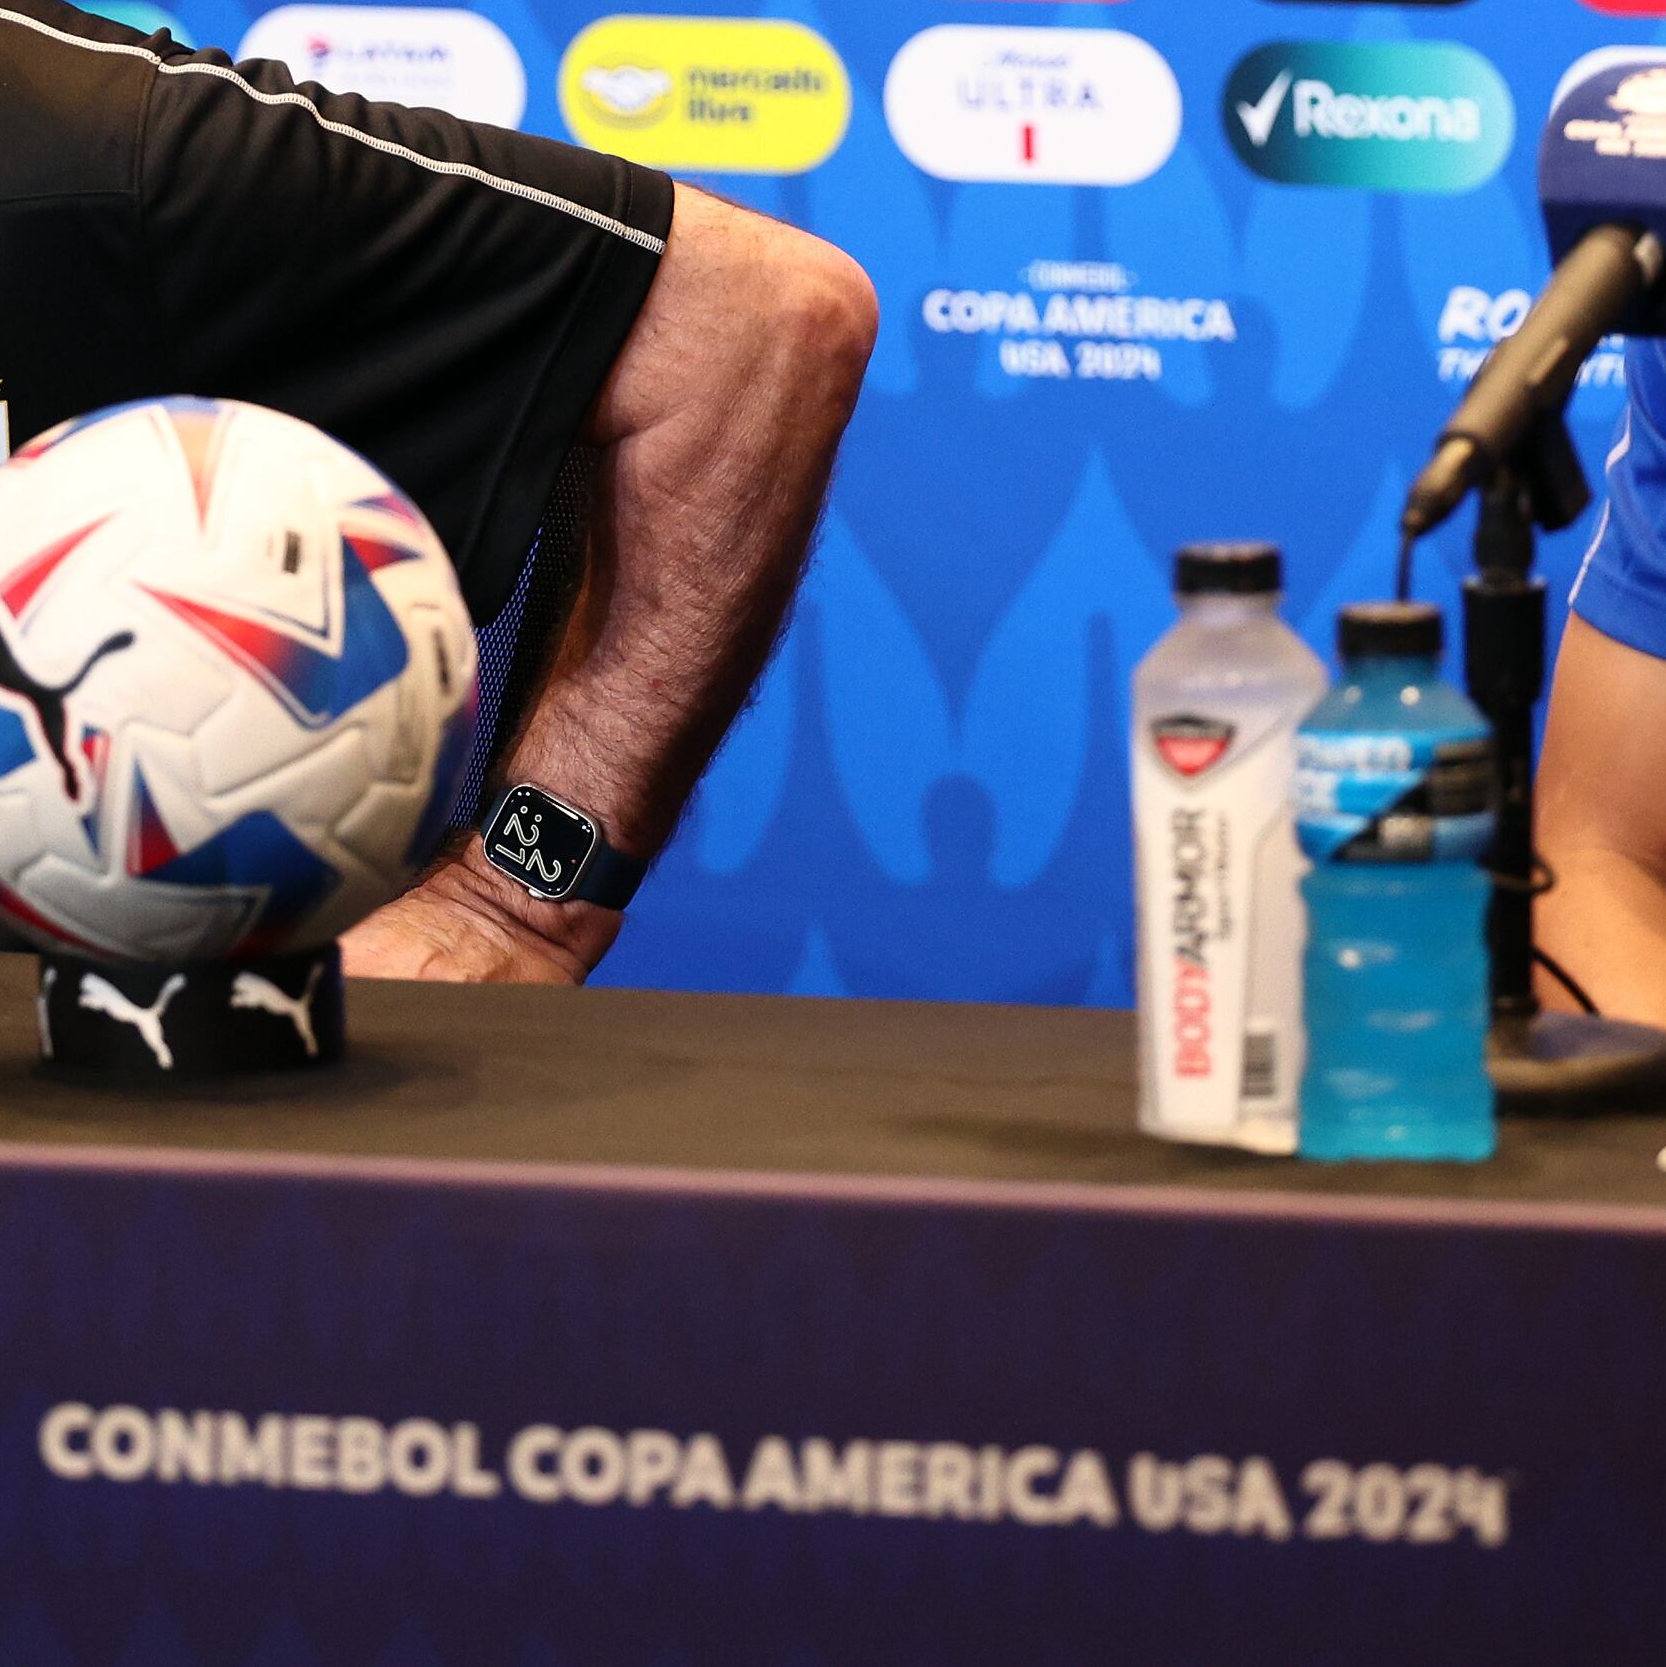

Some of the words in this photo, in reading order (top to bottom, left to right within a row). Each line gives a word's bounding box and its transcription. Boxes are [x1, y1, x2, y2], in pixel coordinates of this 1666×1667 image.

[959, 78, 1102, 112] ULTRA
[1293, 85, 1477, 140] Rexona
[923, 288, 1041, 334] COPA
[1042, 292, 1238, 343] AMERICA
[999, 339, 1071, 379] USA
[39, 1402, 500, 1498] CONMEBOL
[508, 1425, 736, 1508] COPA
[741, 1436, 1117, 1526] AMERICA
[1129, 1455, 1290, 1538] USA
[1304, 1461, 1506, 1543] 2024
